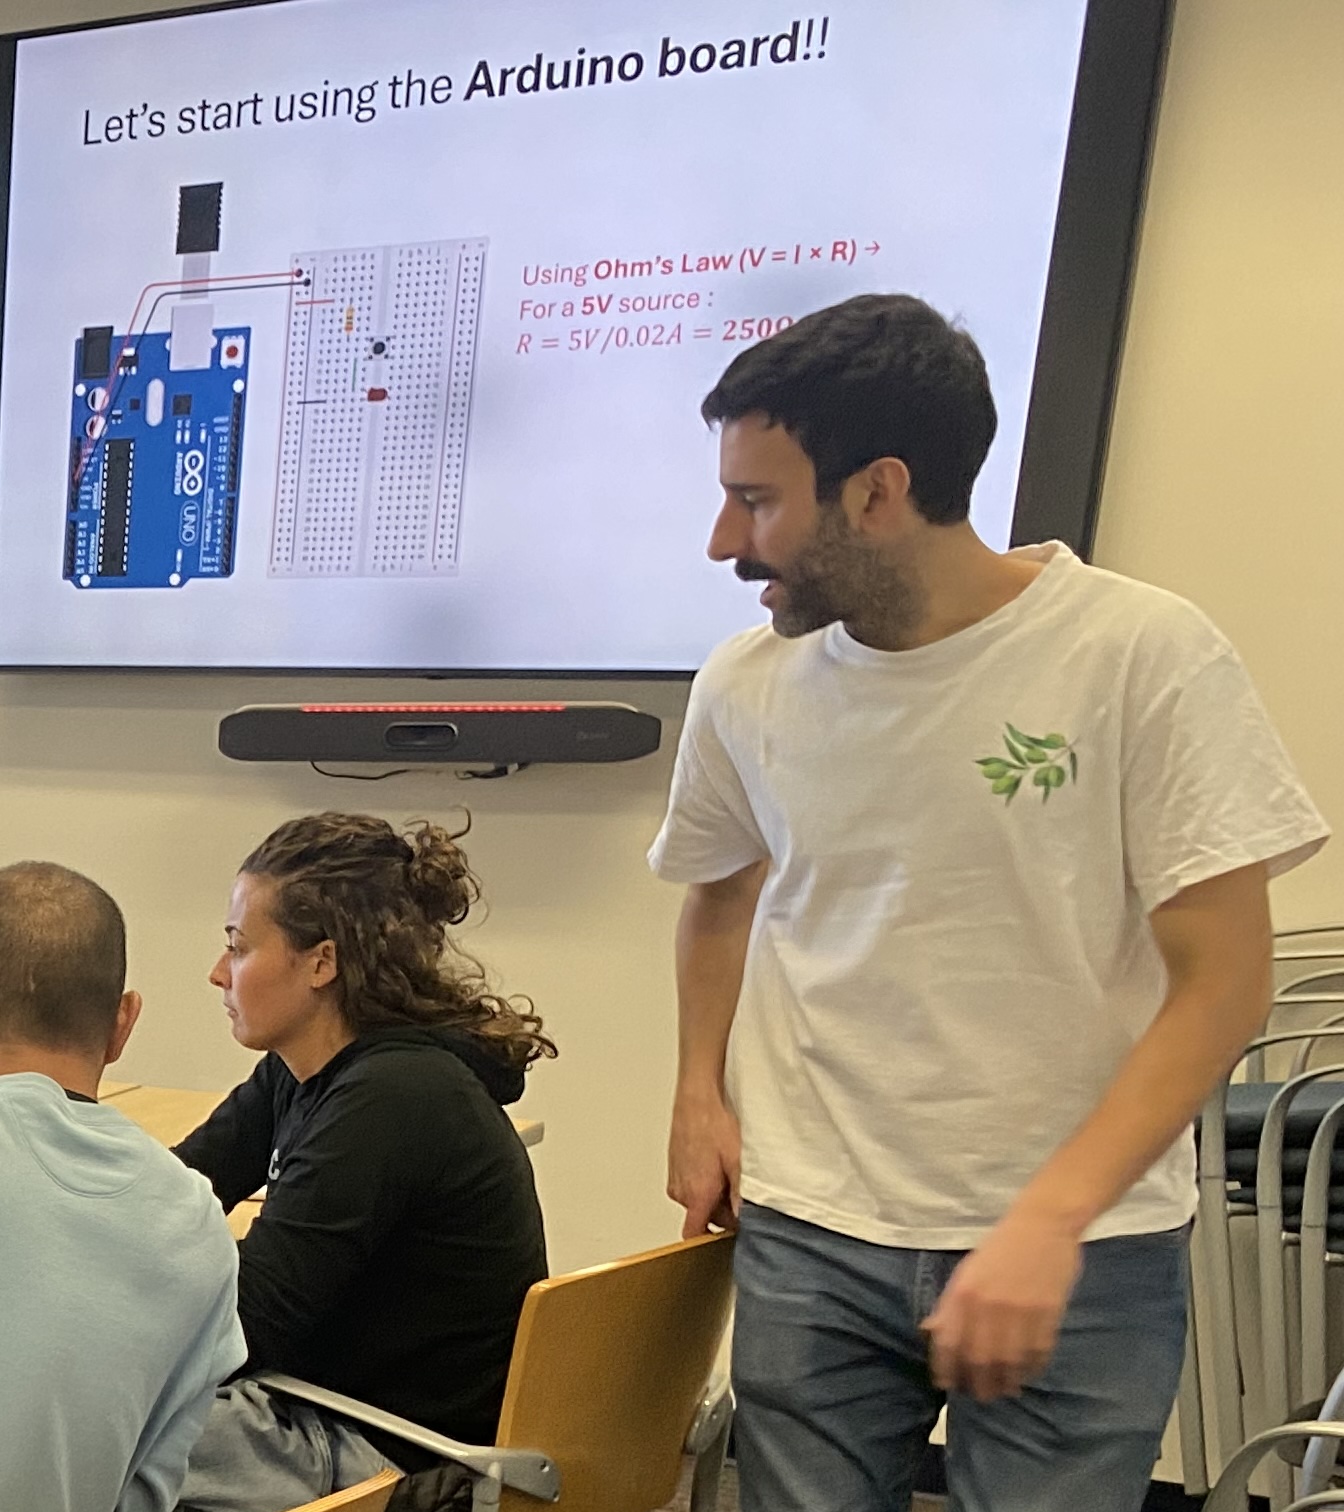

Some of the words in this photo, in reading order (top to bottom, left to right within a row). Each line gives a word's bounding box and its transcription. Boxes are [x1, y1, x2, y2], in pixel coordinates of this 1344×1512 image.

[83, 103, 166, 145] Let's
[176, 92, 264, 135] start
[274, 79, 379, 124] using
[388, 68, 453, 109] the
[462, 47, 644, 101] Arduino
[657, 16, 830, 78] board!!
[522, 263, 589, 288] Using
[593, 256, 674, 281] Ohm's
[681, 252, 734, 274] Law
[738, 246, 767, 274] (V
[770, 250, 787, 261] =
[830, 239, 858, 265] R)
[519, 300, 554, 321] For
[560, 302, 575, 318] a
[581, 294, 614, 316] 5V
[618, 292, 700, 315] source
[516, 333, 533, 355] R
[540, 336, 560, 349] =
[567, 322, 683, 355] 5V/0.02A
[692, 326, 713, 340] =
[182, 505, 197, 542] UNO
